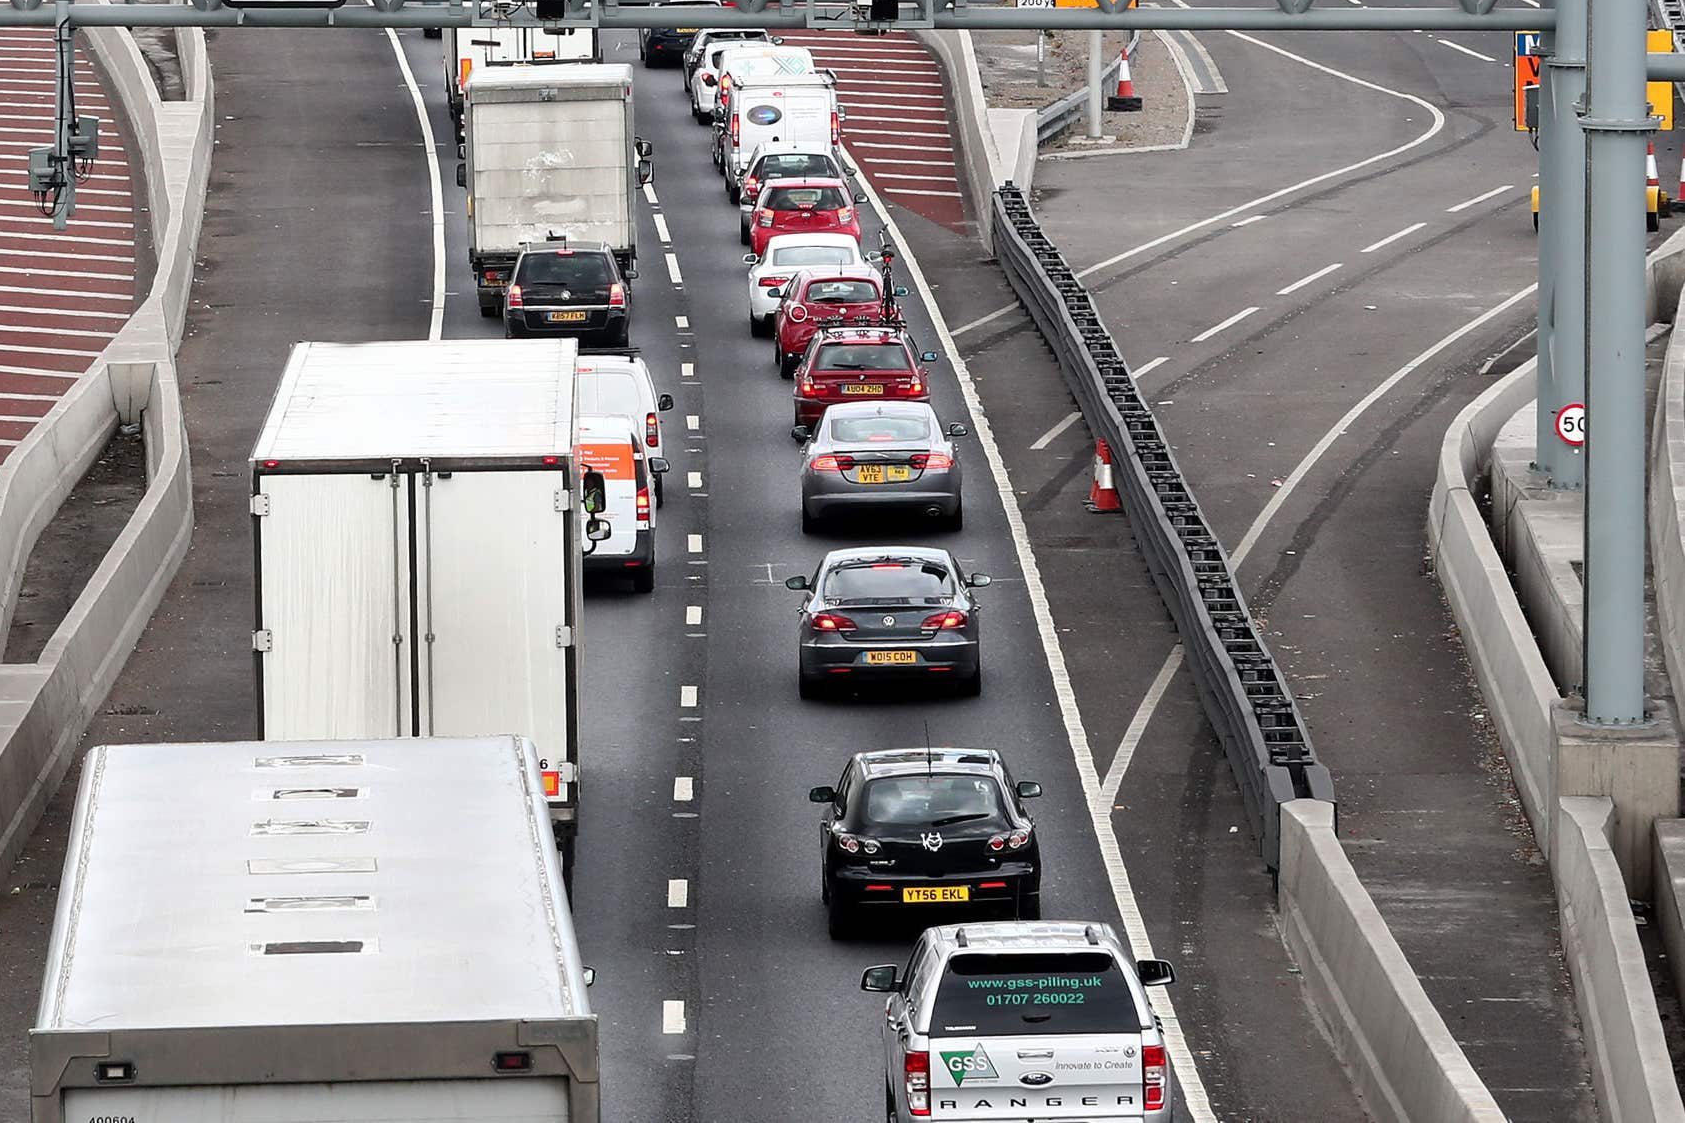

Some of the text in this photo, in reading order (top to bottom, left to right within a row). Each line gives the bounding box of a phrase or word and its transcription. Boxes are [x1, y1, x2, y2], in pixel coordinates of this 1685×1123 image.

[907, 889, 963, 900] YT56 EKL
[968, 976, 1102, 990] www.gss-piling.uk
[986, 993, 1084, 1006] 01707 260022
[948, 1056, 988, 1072] GSS
[1055, 1061, 1092, 1070] Innovate
[1104, 1060, 1133, 1070] Create
[940, 1095, 1134, 1110] RANGER
